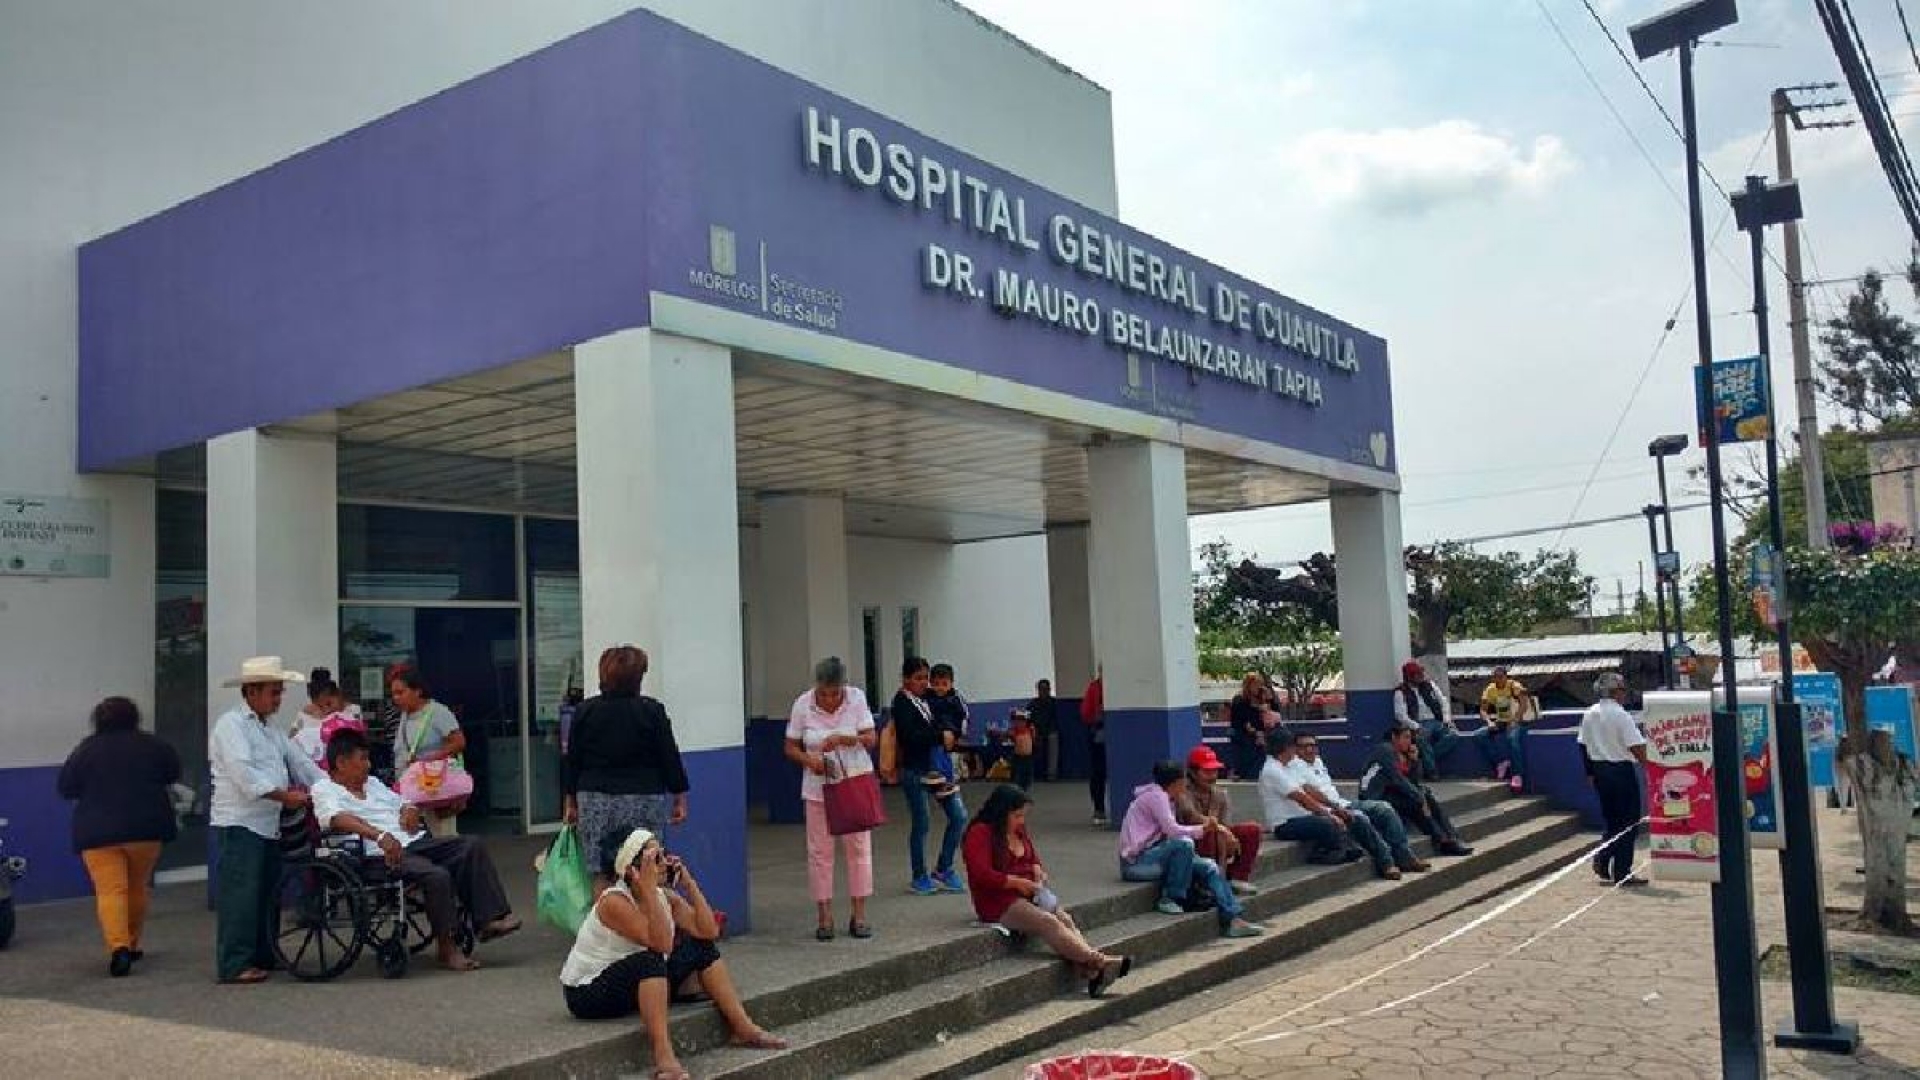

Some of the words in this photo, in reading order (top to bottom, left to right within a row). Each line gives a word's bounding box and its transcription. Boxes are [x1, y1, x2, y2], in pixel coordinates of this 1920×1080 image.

[688, 269, 758, 300] MORELOS
[805, 106, 1040, 250] HOSPITAL
[1050, 213, 1208, 315] GENERAL
[1214, 281, 1252, 331] DE
[1256, 301, 1360, 373] CUAUTLA
[771, 297, 793, 319] de
[795, 303, 836, 330] Salud
[926, 242, 985, 299] DR.
[994, 268, 1100, 336] MAURO
[1109, 308, 1268, 389] BELAUNZARAN
[1273, 362, 1323, 408] TAPIA
